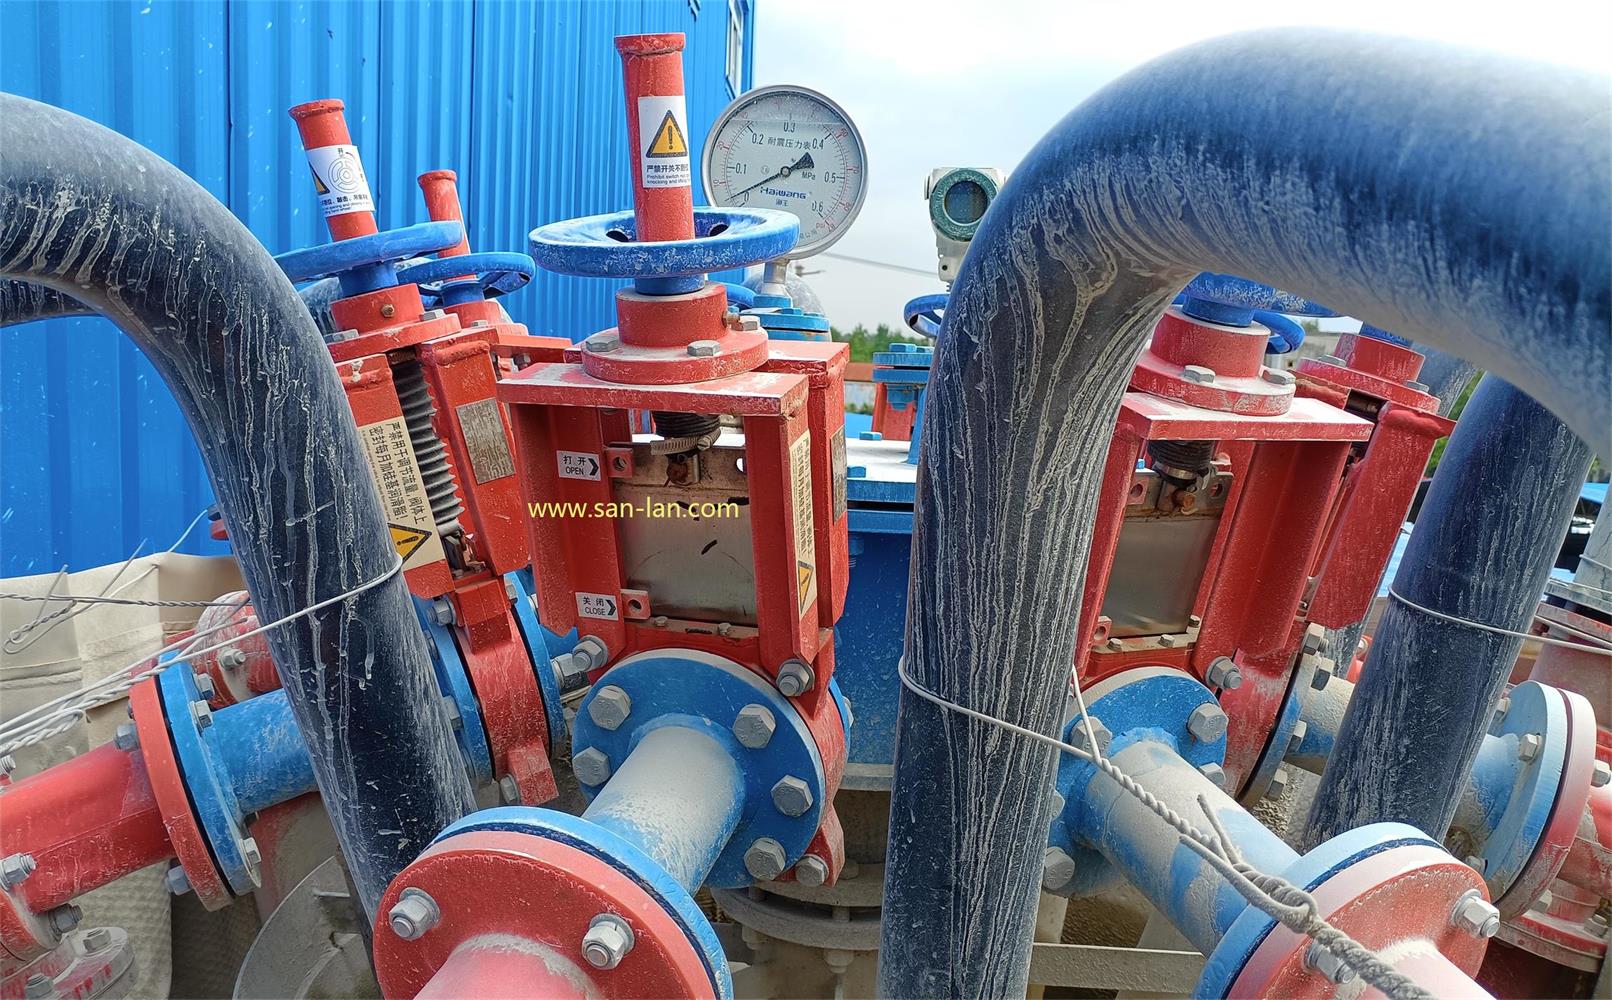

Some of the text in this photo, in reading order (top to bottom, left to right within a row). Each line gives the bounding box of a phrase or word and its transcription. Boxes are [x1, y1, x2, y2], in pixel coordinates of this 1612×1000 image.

[751, 133, 764, 145] 0.2
[767, 136, 811, 150] 耐震压力表
[812, 138, 824, 150] 0.4
[735, 162, 747, 174] 0.1
[801, 171, 816, 180] MPa
[824, 171, 836, 184] 0.5
[811, 200, 824, 212] 0.6
[563, 455, 586, 466] 打开
[565, 466, 584, 475] OPEN
[583, 596, 605, 607] 关闭
[584, 606, 606, 616] CLOSE
